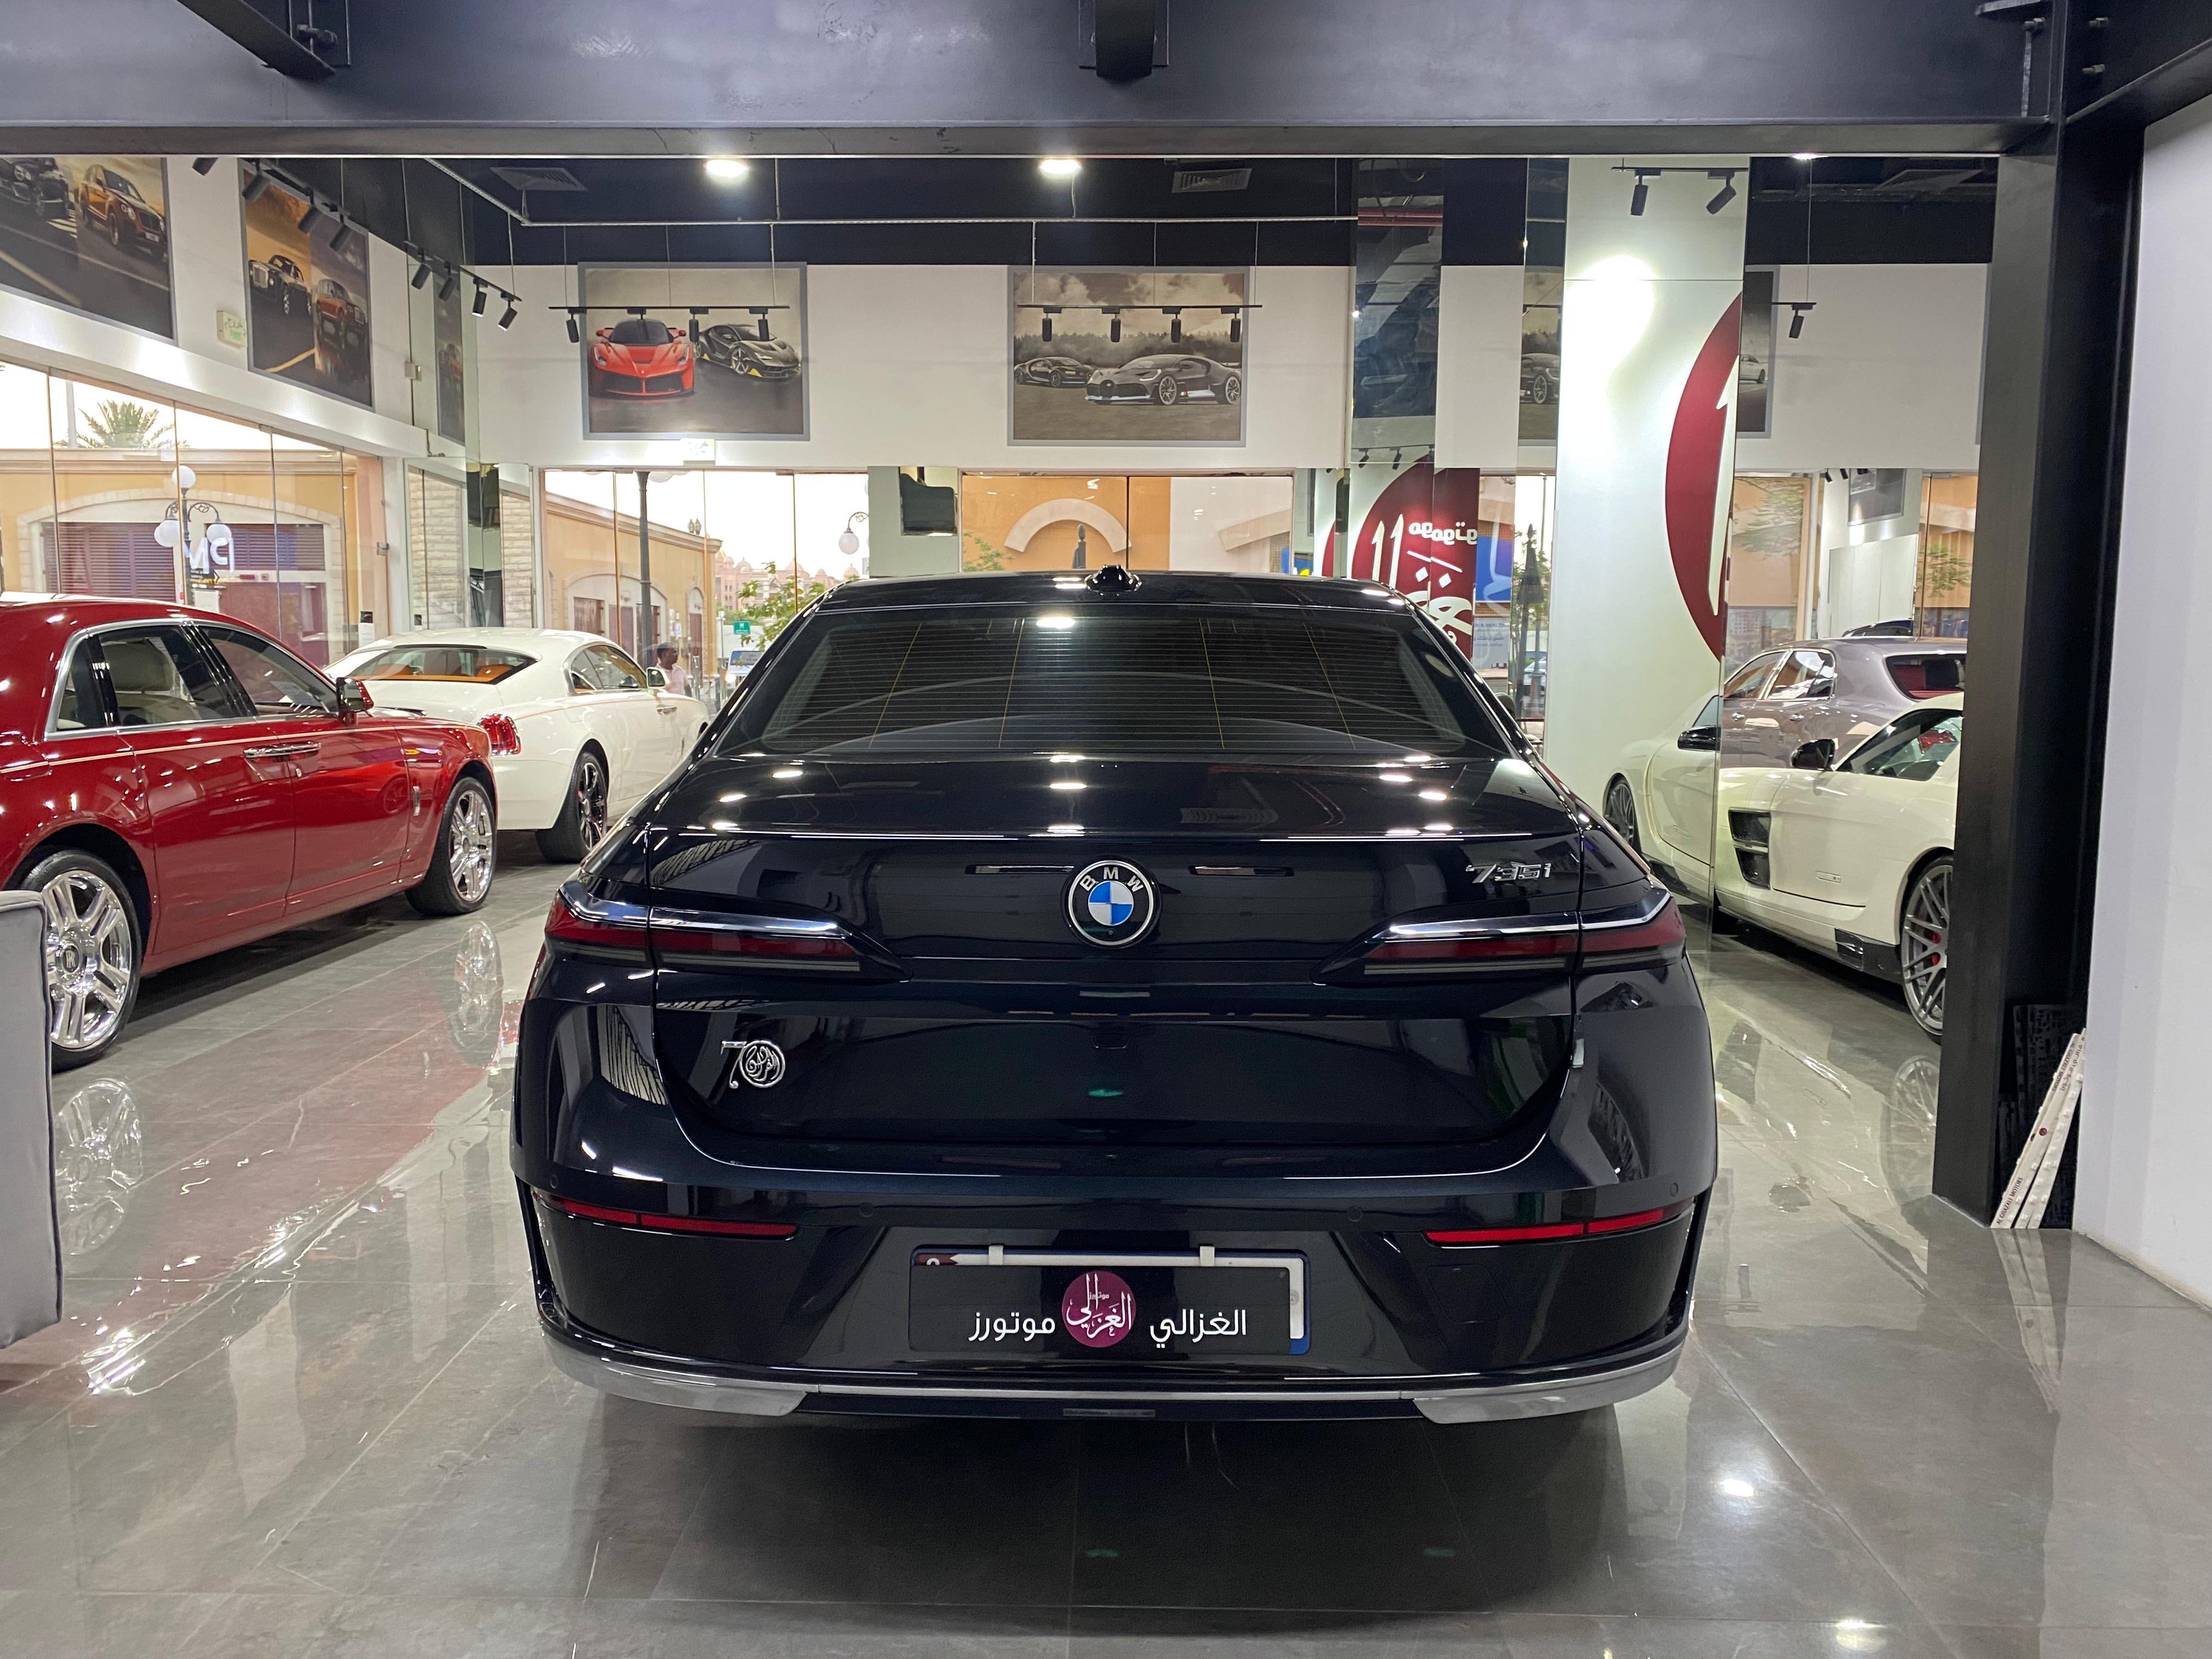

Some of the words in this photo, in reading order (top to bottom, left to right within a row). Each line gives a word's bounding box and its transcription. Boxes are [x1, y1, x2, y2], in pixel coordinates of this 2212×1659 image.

[1080, 866, 1144, 892] BMW
[1466, 861, 1551, 884] 735i
[968, 1312, 1056, 1342] موتورز
[1150, 1308, 1246, 1348] الغزالي
